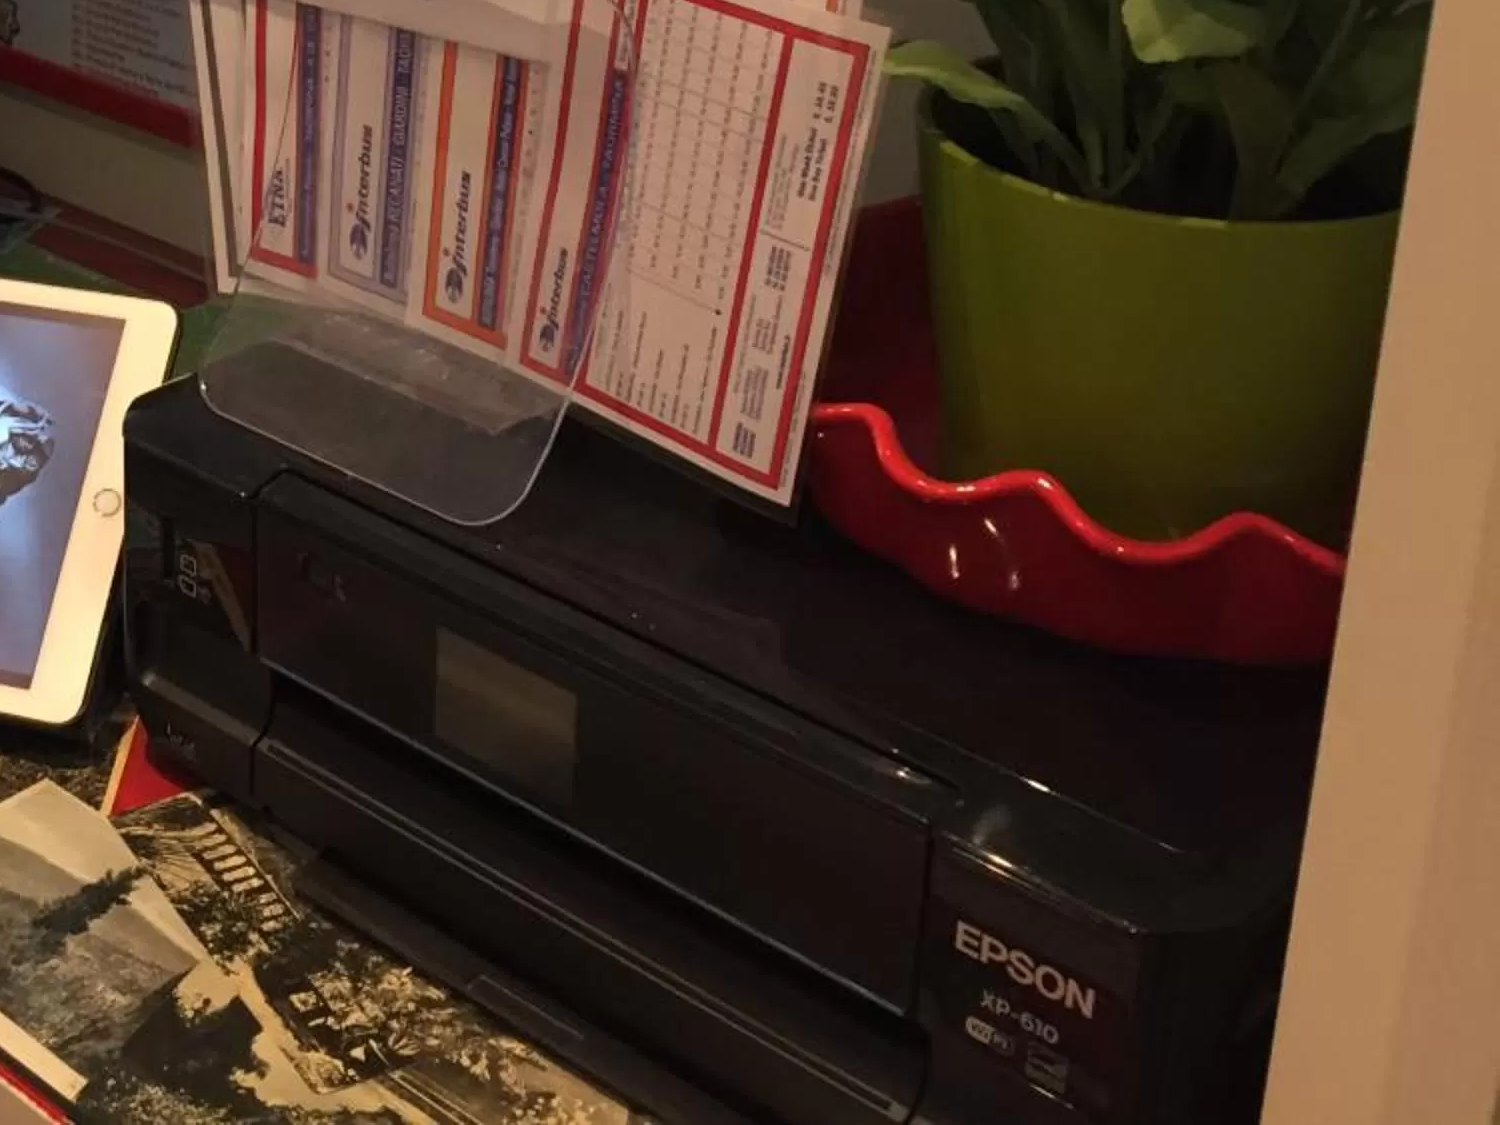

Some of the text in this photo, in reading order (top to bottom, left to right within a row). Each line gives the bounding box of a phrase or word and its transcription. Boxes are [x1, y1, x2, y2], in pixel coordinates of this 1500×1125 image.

[266, 168, 288, 229] ETNA
[346, 124, 374, 234] interbus
[443, 170, 472, 278] interbus
[539, 246, 569, 332] interbus
[955, 919, 1097, 1020] EPSON
[979, 988, 1060, 1045] XP-610
